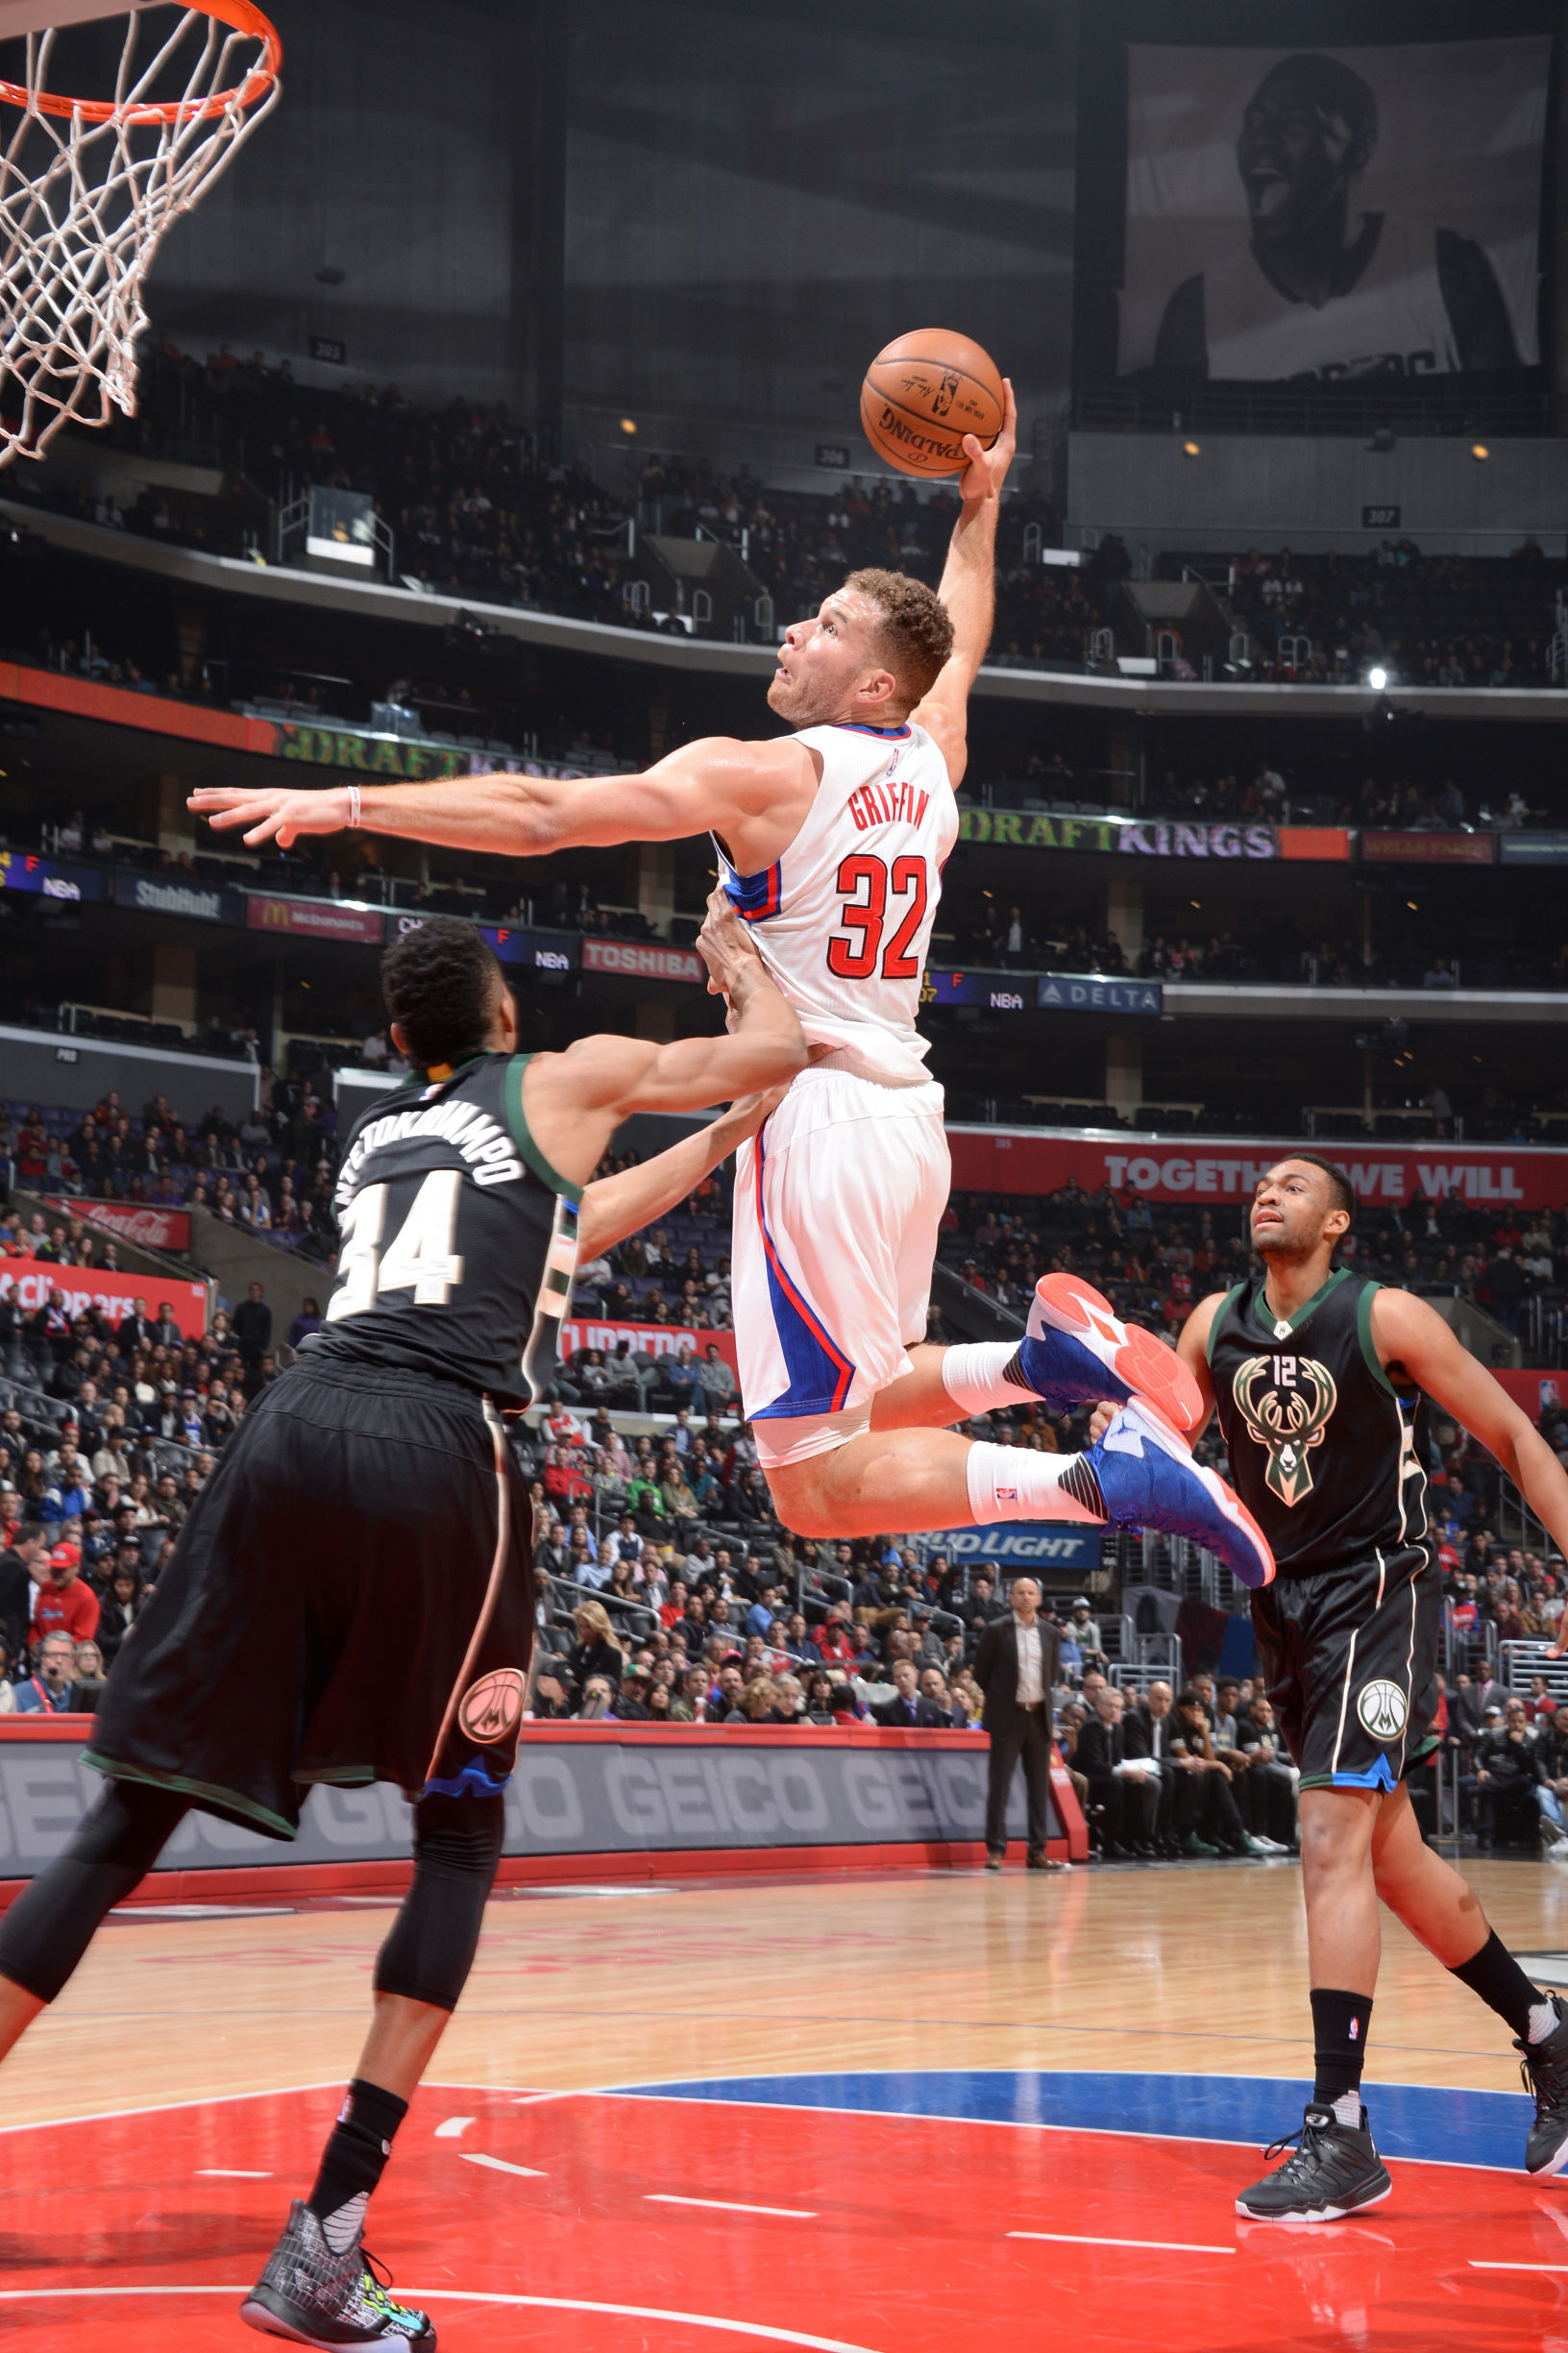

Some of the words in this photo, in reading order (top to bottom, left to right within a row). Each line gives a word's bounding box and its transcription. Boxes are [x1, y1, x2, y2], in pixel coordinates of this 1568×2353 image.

[848, 781, 929, 831] GRIFFIN
[292, 912, 365, 932] McDonald's
[827, 854, 927, 979] 32
[498, 929, 511, 944] F
[535, 950, 570, 971] NBA
[584, 943, 700, 978] TOSHIBA
[952, 972, 965, 988] F
[990, 993, 1023, 1010] NBA
[1070, 985, 1158, 1009] DELTA
[1416, 1164, 1523, 1200] WILL
[327, 1169, 465, 1322] 34
[1273, 1356, 1297, 1386] 12
[980, 1532, 1085, 1558] LIGHT
[603, 1756, 828, 1836] GEICO
